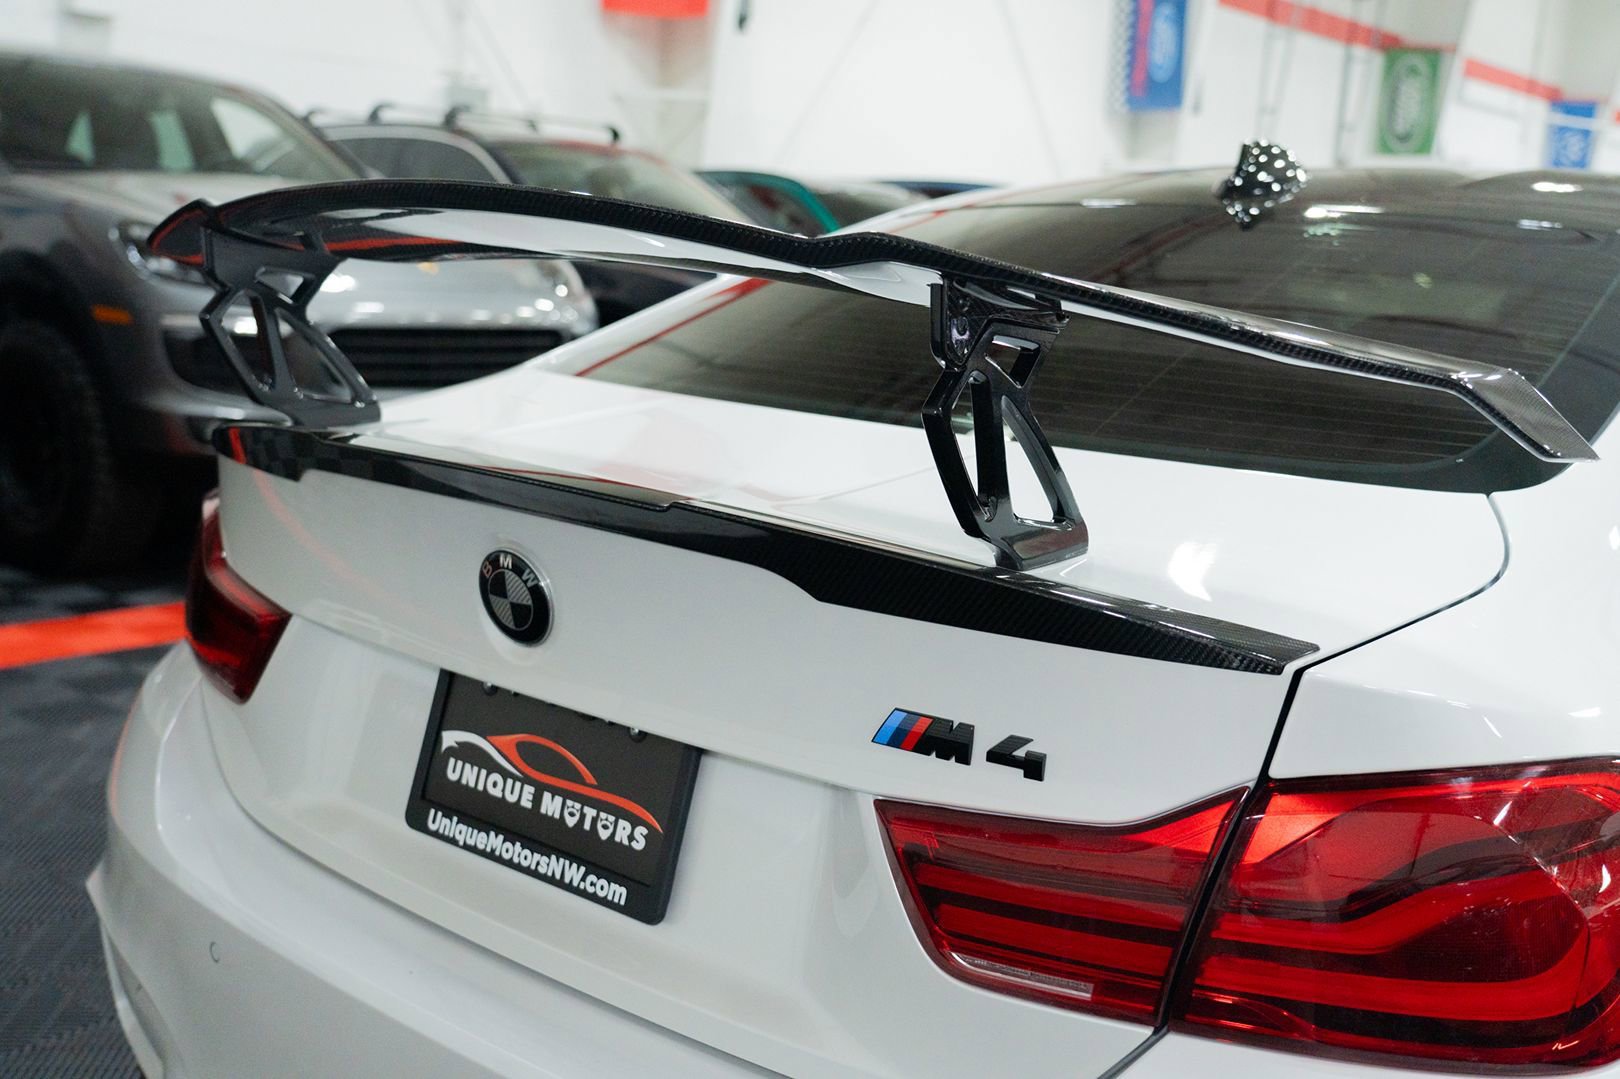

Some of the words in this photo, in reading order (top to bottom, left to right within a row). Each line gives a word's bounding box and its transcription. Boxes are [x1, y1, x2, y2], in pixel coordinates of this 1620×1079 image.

[482, 553, 539, 588] BMW
[446, 757, 536, 809] UNIQUE
[540, 790, 649, 851] MOTORS
[427, 807, 628, 905] UniqueMotorsNW.com
